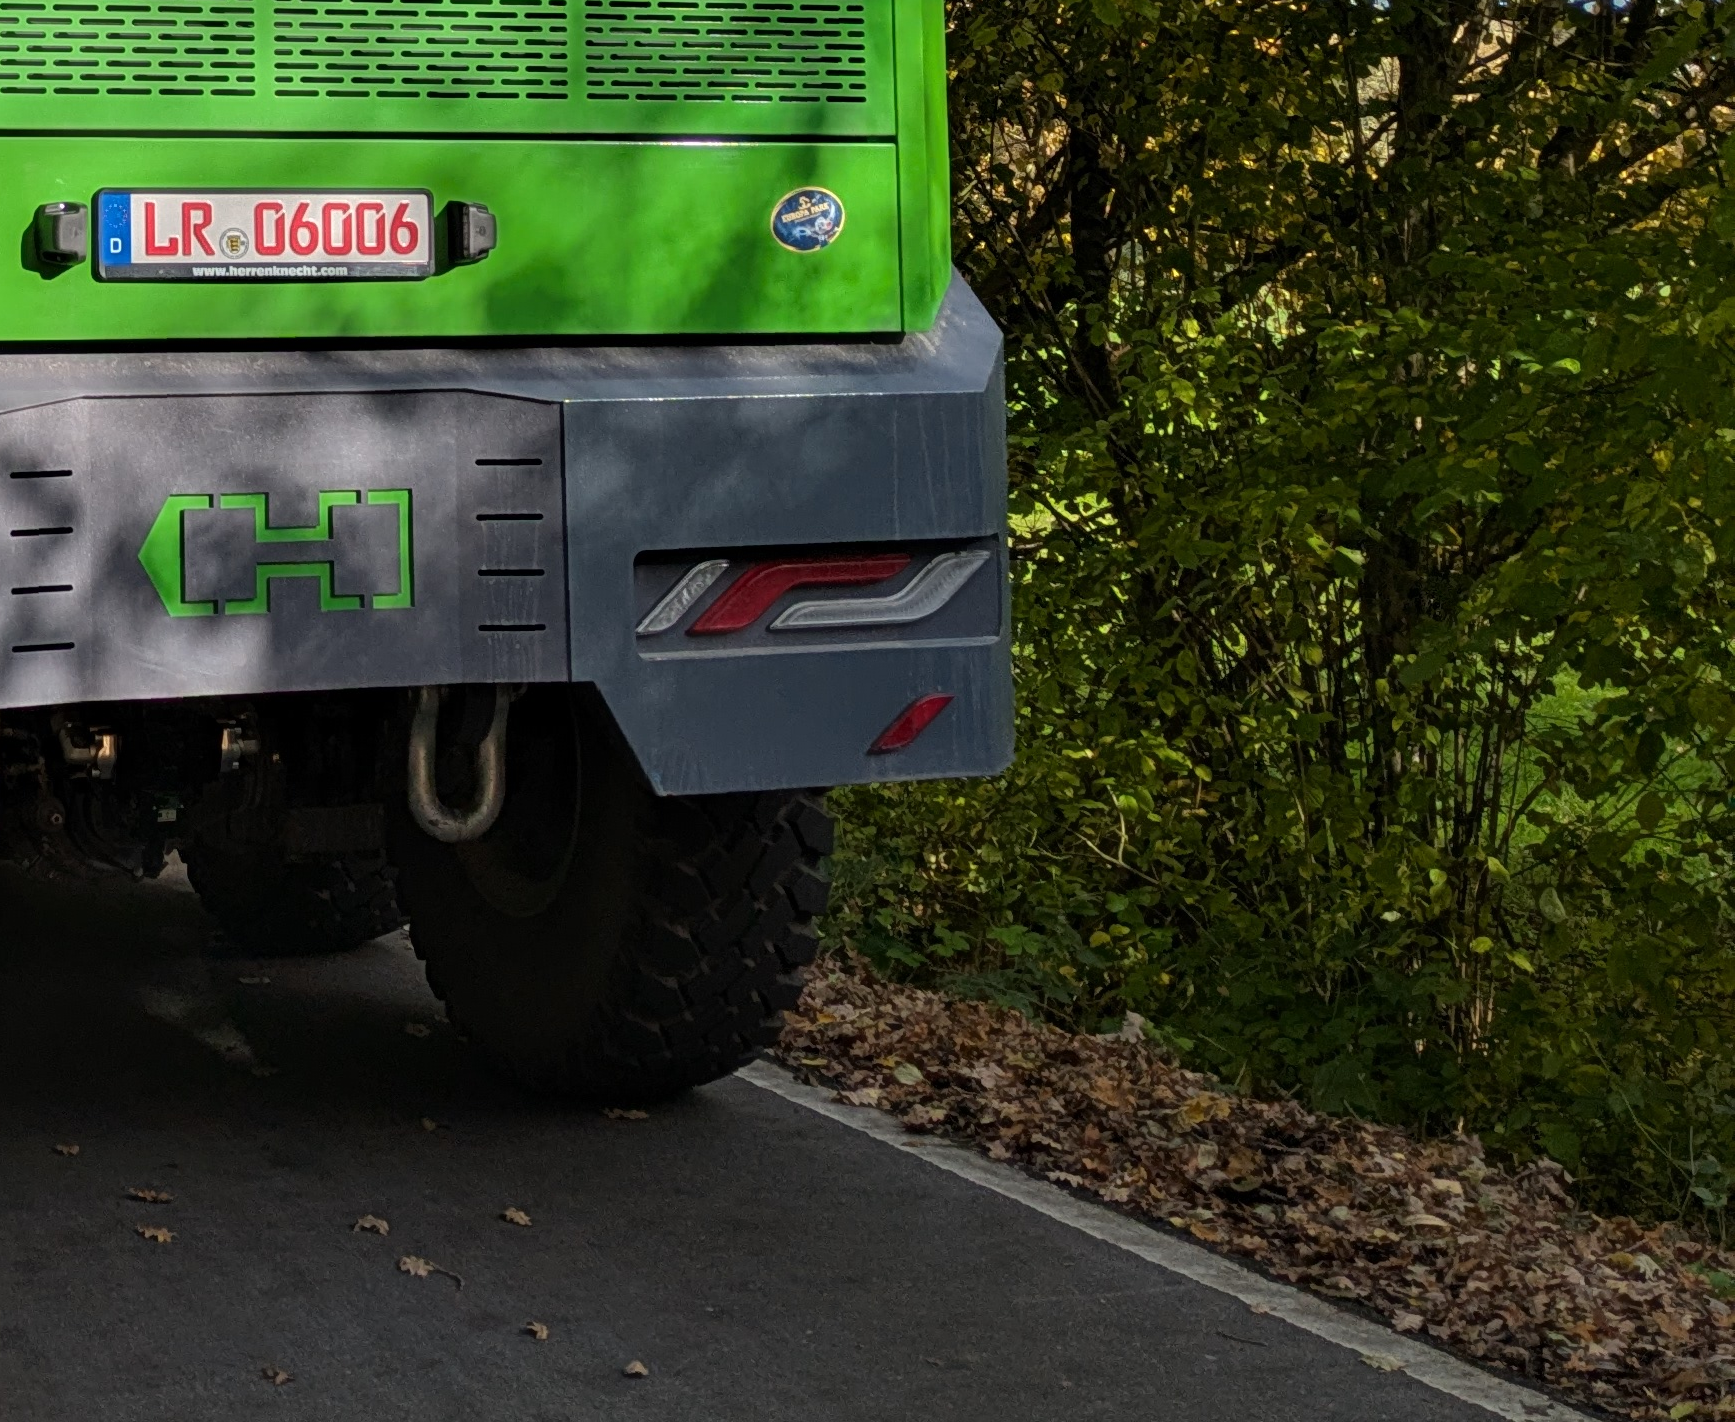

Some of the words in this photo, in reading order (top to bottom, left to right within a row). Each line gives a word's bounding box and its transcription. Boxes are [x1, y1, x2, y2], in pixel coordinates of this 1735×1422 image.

[144, 201, 216, 256] LR
[253, 201, 419, 256] 06006
[110, 237, 122, 253] D
[192, 264, 348, 278] www.herrenknecht.com
